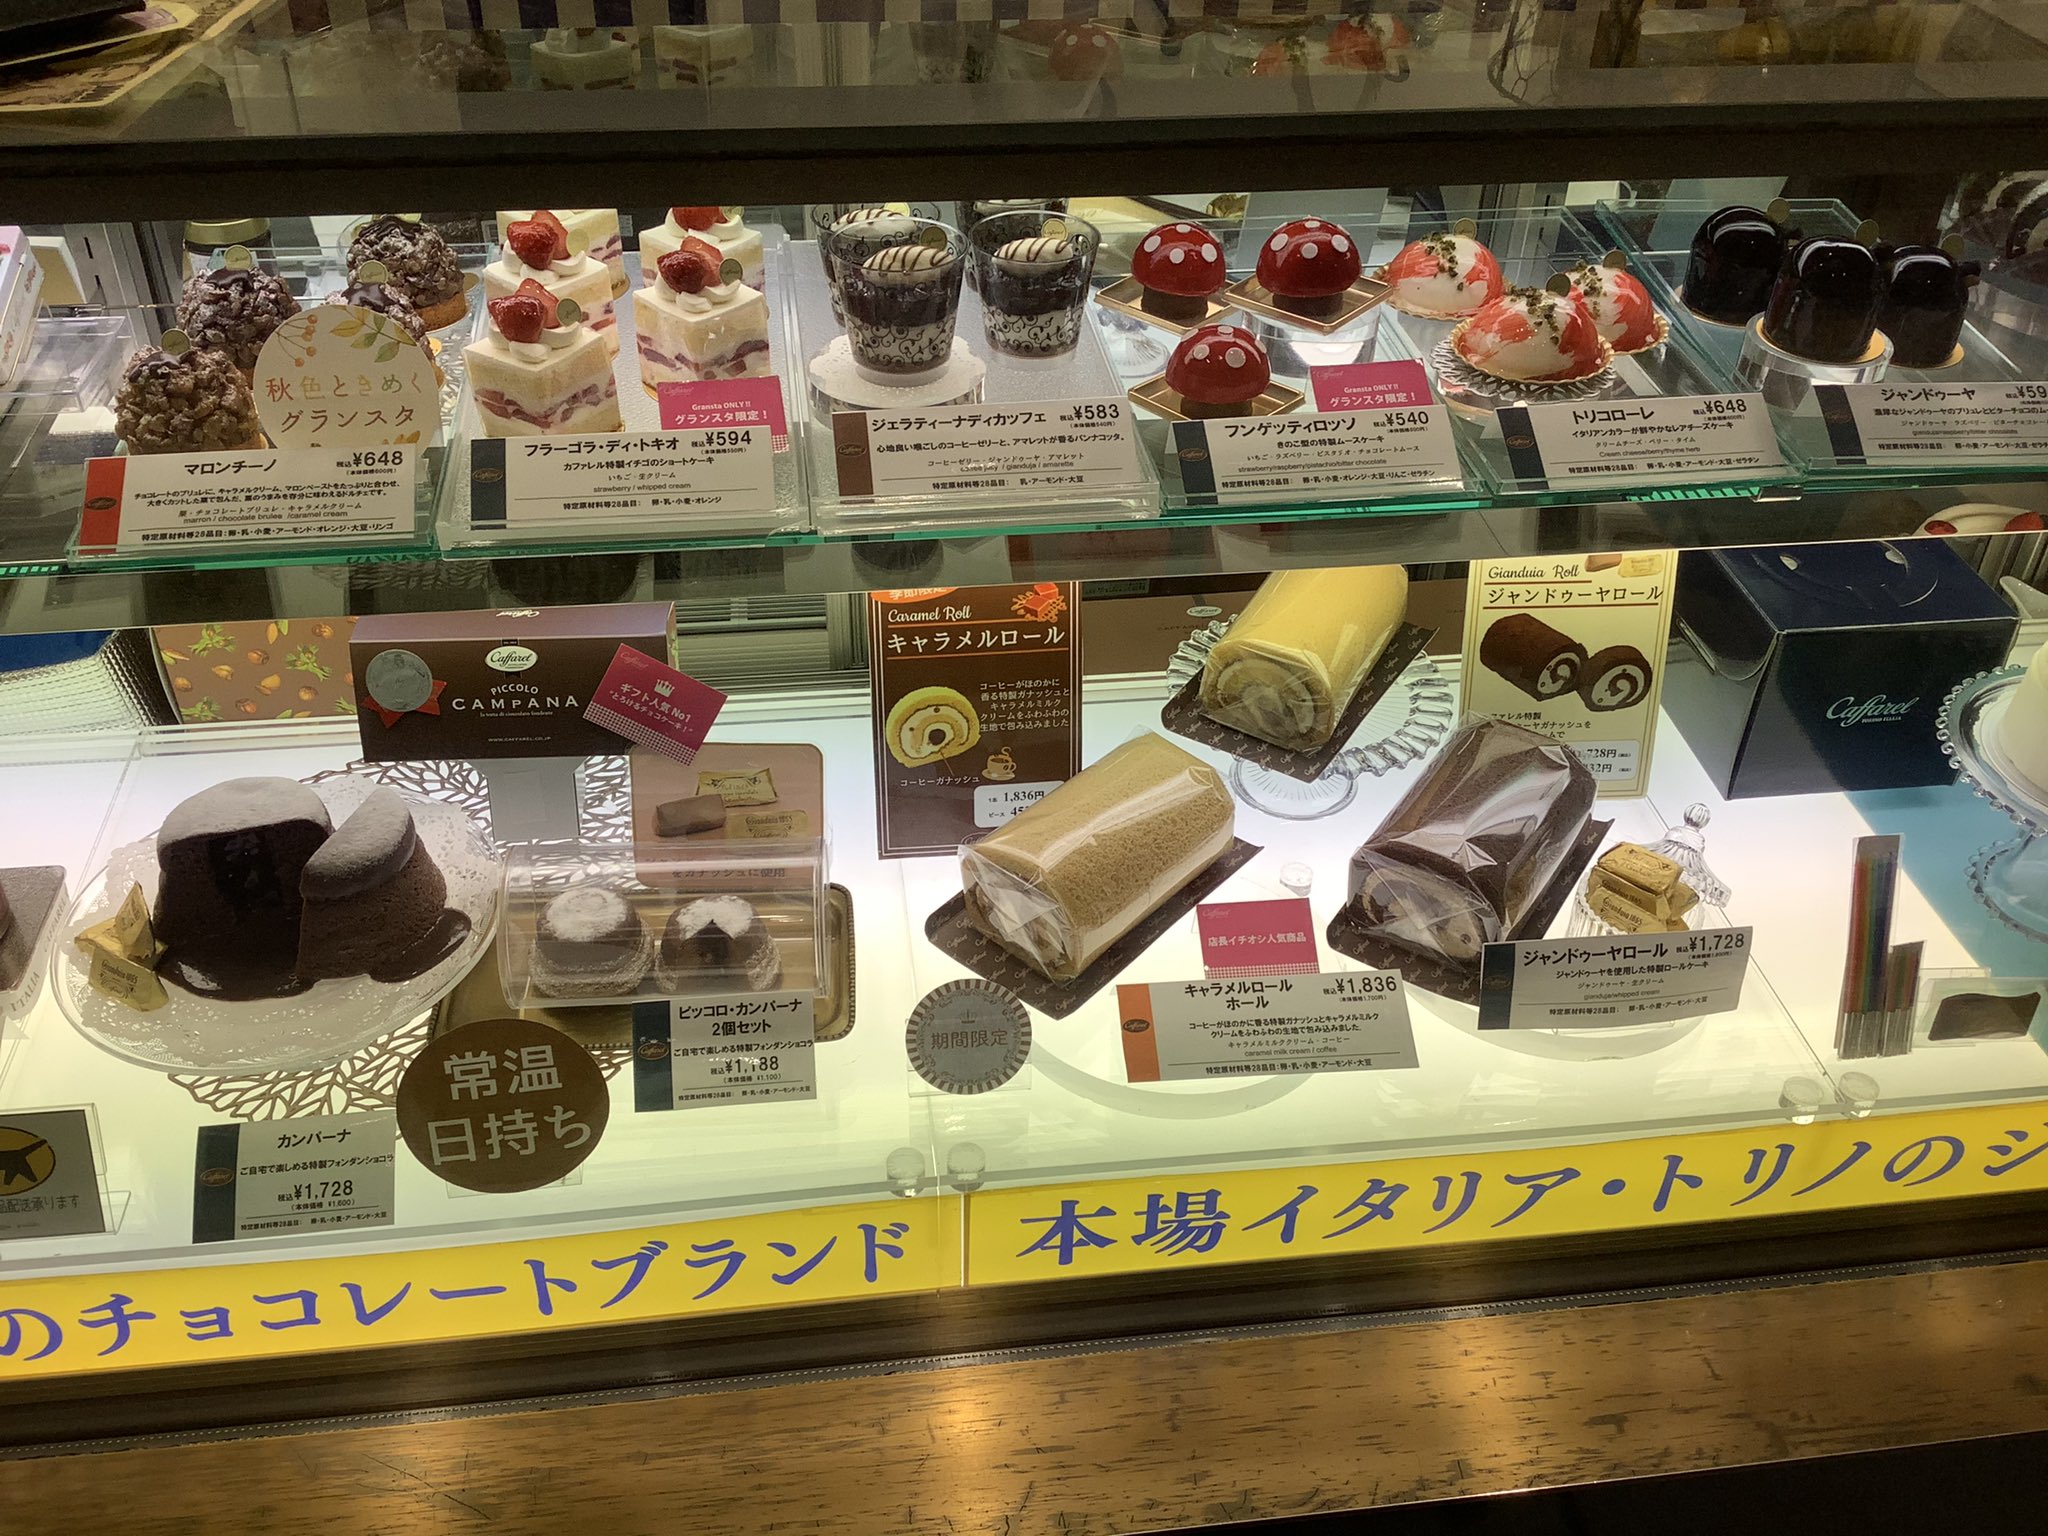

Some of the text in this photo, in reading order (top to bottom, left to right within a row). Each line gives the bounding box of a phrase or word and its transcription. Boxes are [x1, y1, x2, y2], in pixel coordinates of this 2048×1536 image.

[265, 373, 423, 402] 秋色ときめく
[1344, 386, 1372, 394] Gransta
[1881, 388, 1976, 401] ジャンドゥーヤ
[691, 402, 722, 411] Gransta
[1572, 406, 1655, 425] トリコローレ
[1704, 399, 1747, 414] ¥648
[280, 404, 415, 434] グランスタ
[872, 410, 1047, 432] ジェラティーナディカッフェ
[1073, 404, 1120, 420] ¥583
[1224, 417, 1356, 438] フンゲッティロッソ
[1385, 411, 1429, 426] ¥540
[524, 436, 679, 457] フラーゴラ・ディ・トキオ
[705, 430, 751, 447] ¥594
[184, 458, 277, 475] マロンチーノ
[352, 450, 403, 467] ¥648
[1355, 458, 1387, 466] chocolate
[593, 482, 691, 494] strawberry whipped cream
[183, 516, 211, 524] marron
[218, 514, 256, 522] chocolate
[1488, 564, 1580, 579] Gianduia Roll
[1488, 586, 1663, 605] ジャンドゥーヤロール
[888, 605, 972, 623] Caramel Roll
[887, 626, 1065, 654] キャラメルロール
[490, 651, 534, 667] Caffarel
[490, 683, 539, 696] PICCOLO
[980, 679, 1060, 690] コーヒーがほのかに
[452, 695, 579, 710] CAMPANA
[620, 683, 669, 713] ギフト人気
[981, 688, 1070, 701] 香る特製ガナッシュと
[990, 699, 1061, 711] キャラメルミルク
[1826, 694, 1920, 727] Caffarel
[980, 709, 1069, 721] クリームをふわふわの
[980, 719, 1069, 732] 生地で包み込みました
[900, 777, 980, 787] コーヒーガナッシュ
[1003, 790, 1045, 802] 1,836円
[1208, 932, 1306, 947] 店長イチオシ人気商品
[1524, 942, 1669, 966] ジャンドゥーヤロール
[1689, 933, 1745, 952] ¥1,728
[1184, 979, 1293, 998] キャラメルロール
[1336, 975, 1398, 994] ¥1,836
[1226, 995, 1270, 1011] ホール
[712, 1019, 772, 1036] 2個セット
[673, 1039, 814, 1057] ご自宅で楽しめる特製フォンダンショコラ
[931, 1029, 1009, 1050] 期間限定
[1244, 1049, 1272, 1057] caramel
[1273, 1048, 1288, 1056] milk
[443, 1044, 563, 1100] 常温
[277, 1129, 352, 1149] カンパーナ
[427, 1105, 592, 1166] 日持ち
[239, 1153, 394, 1176] ご自宅で楽しめる特製フォンダンショコラ
[294, 1179, 354, 1201] ¥1,728
[0, 1222, 909, 1361] のチョコレートブランド
